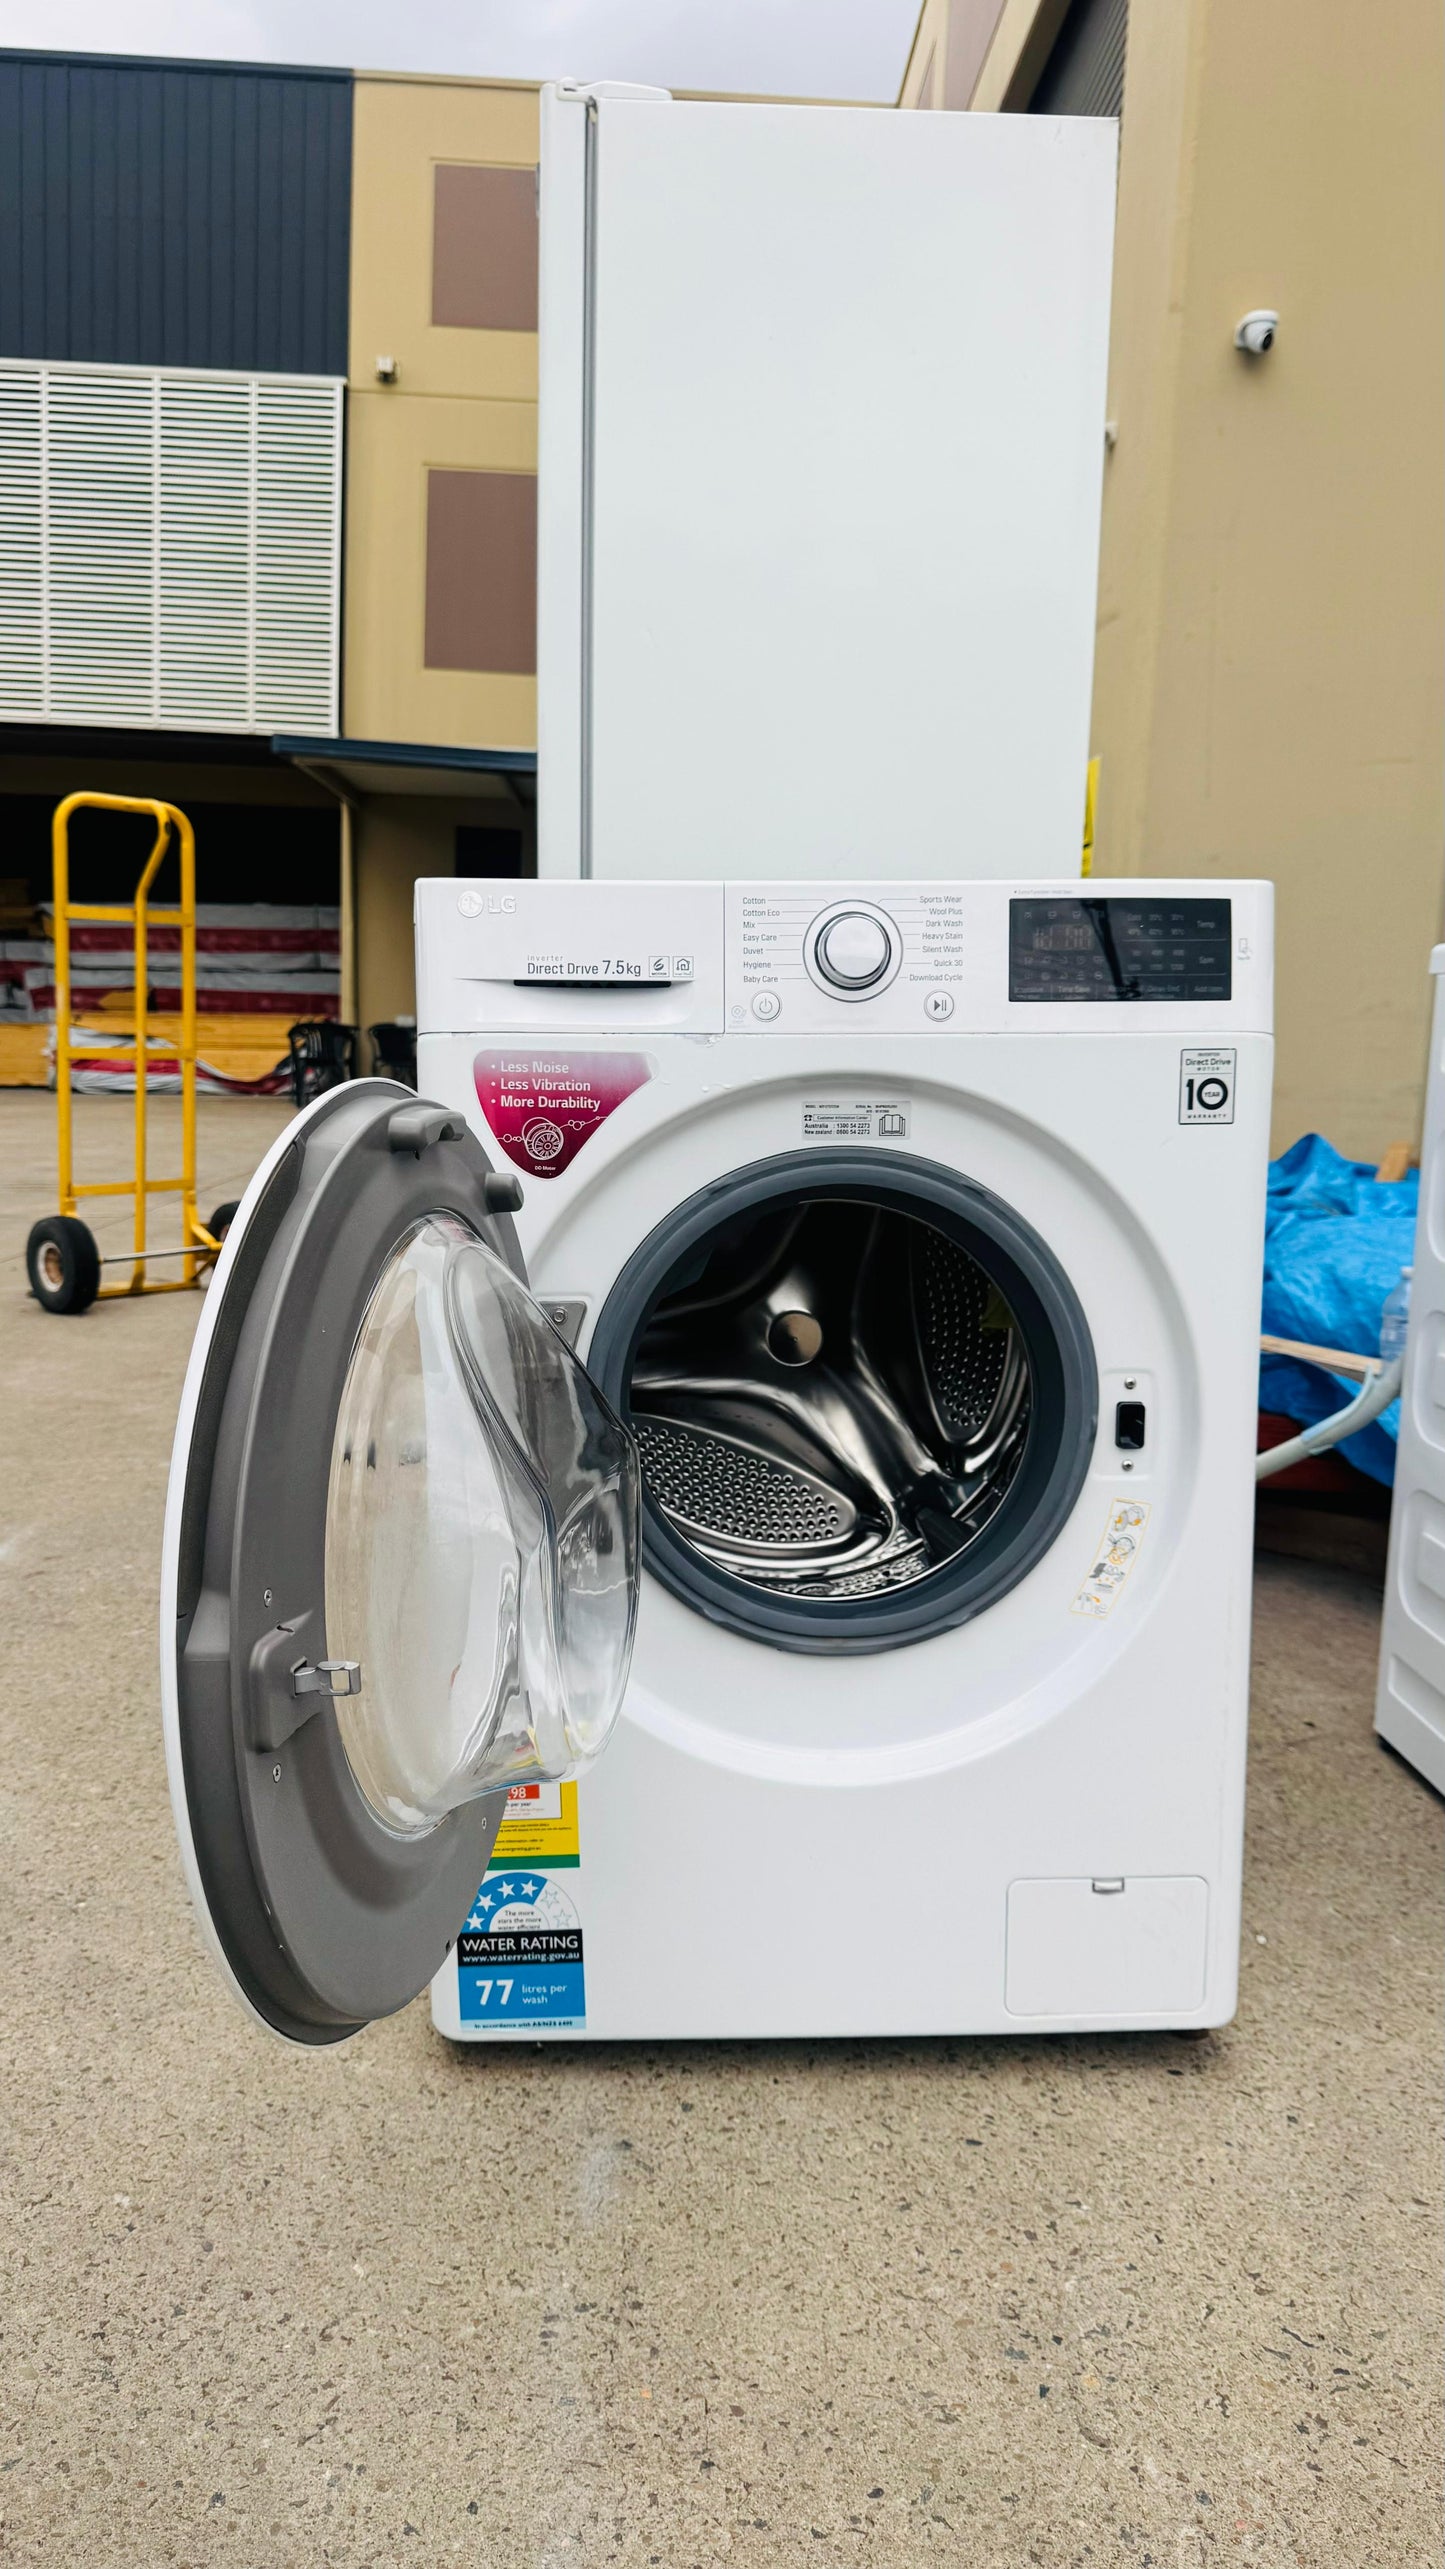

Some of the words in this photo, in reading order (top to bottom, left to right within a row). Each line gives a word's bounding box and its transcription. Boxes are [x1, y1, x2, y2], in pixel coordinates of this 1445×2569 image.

[487, 895, 517, 914] LG
[742, 896, 766, 905] Cotton
[919, 896, 942, 904] Sports
[742, 908, 766, 917] Cotton
[767, 908, 780, 917] Eco
[947, 907, 963, 915] Plus
[742, 921, 756, 929] Mix
[925, 919, 942, 927] Dark
[942, 919, 963, 927] Wash
[743, 933, 759, 943] Easy
[760, 933, 777, 942] Care
[922, 932, 944, 941] Heavy
[945, 932, 963, 940] Stain
[743, 947, 764, 955] Duvet
[922, 945, 941, 953] Silent
[942, 945, 963, 953] Wash
[743, 961, 772, 970] Hygiene
[933, 959, 952, 967] Quick
[954, 959, 963, 967] 30
[527, 961, 564, 975] Direct
[567, 961, 599, 975] Drive
[743, 975, 760, 985] Baby
[761, 975, 779, 983] Care
[909, 973, 943, 982] Download
[944, 973, 963, 983] Cycle
[1185, 1058, 1209, 1066] Direct
[1210, 1058, 1231, 1066] Drive
[500, 1061, 529, 1073] Less
[532, 1061, 569, 1074] Noise
[500, 1078, 529, 1091] Less
[531, 1078, 591, 1092] Vibration
[1186, 1077, 1228, 1110] 10
[500, 1095, 535, 1108] More
[538, 1095, 601, 1112] Durability
[463, 1937, 516, 1951] WATER
[520, 1935, 579, 1950] RATING
[462, 1951, 580, 1963] www.waterrating.gov.au
[476, 1979, 514, 2006] 77
[522, 1984, 547, 1993] litres
[550, 1985, 568, 1995] per
[522, 1996, 548, 2005] wash
